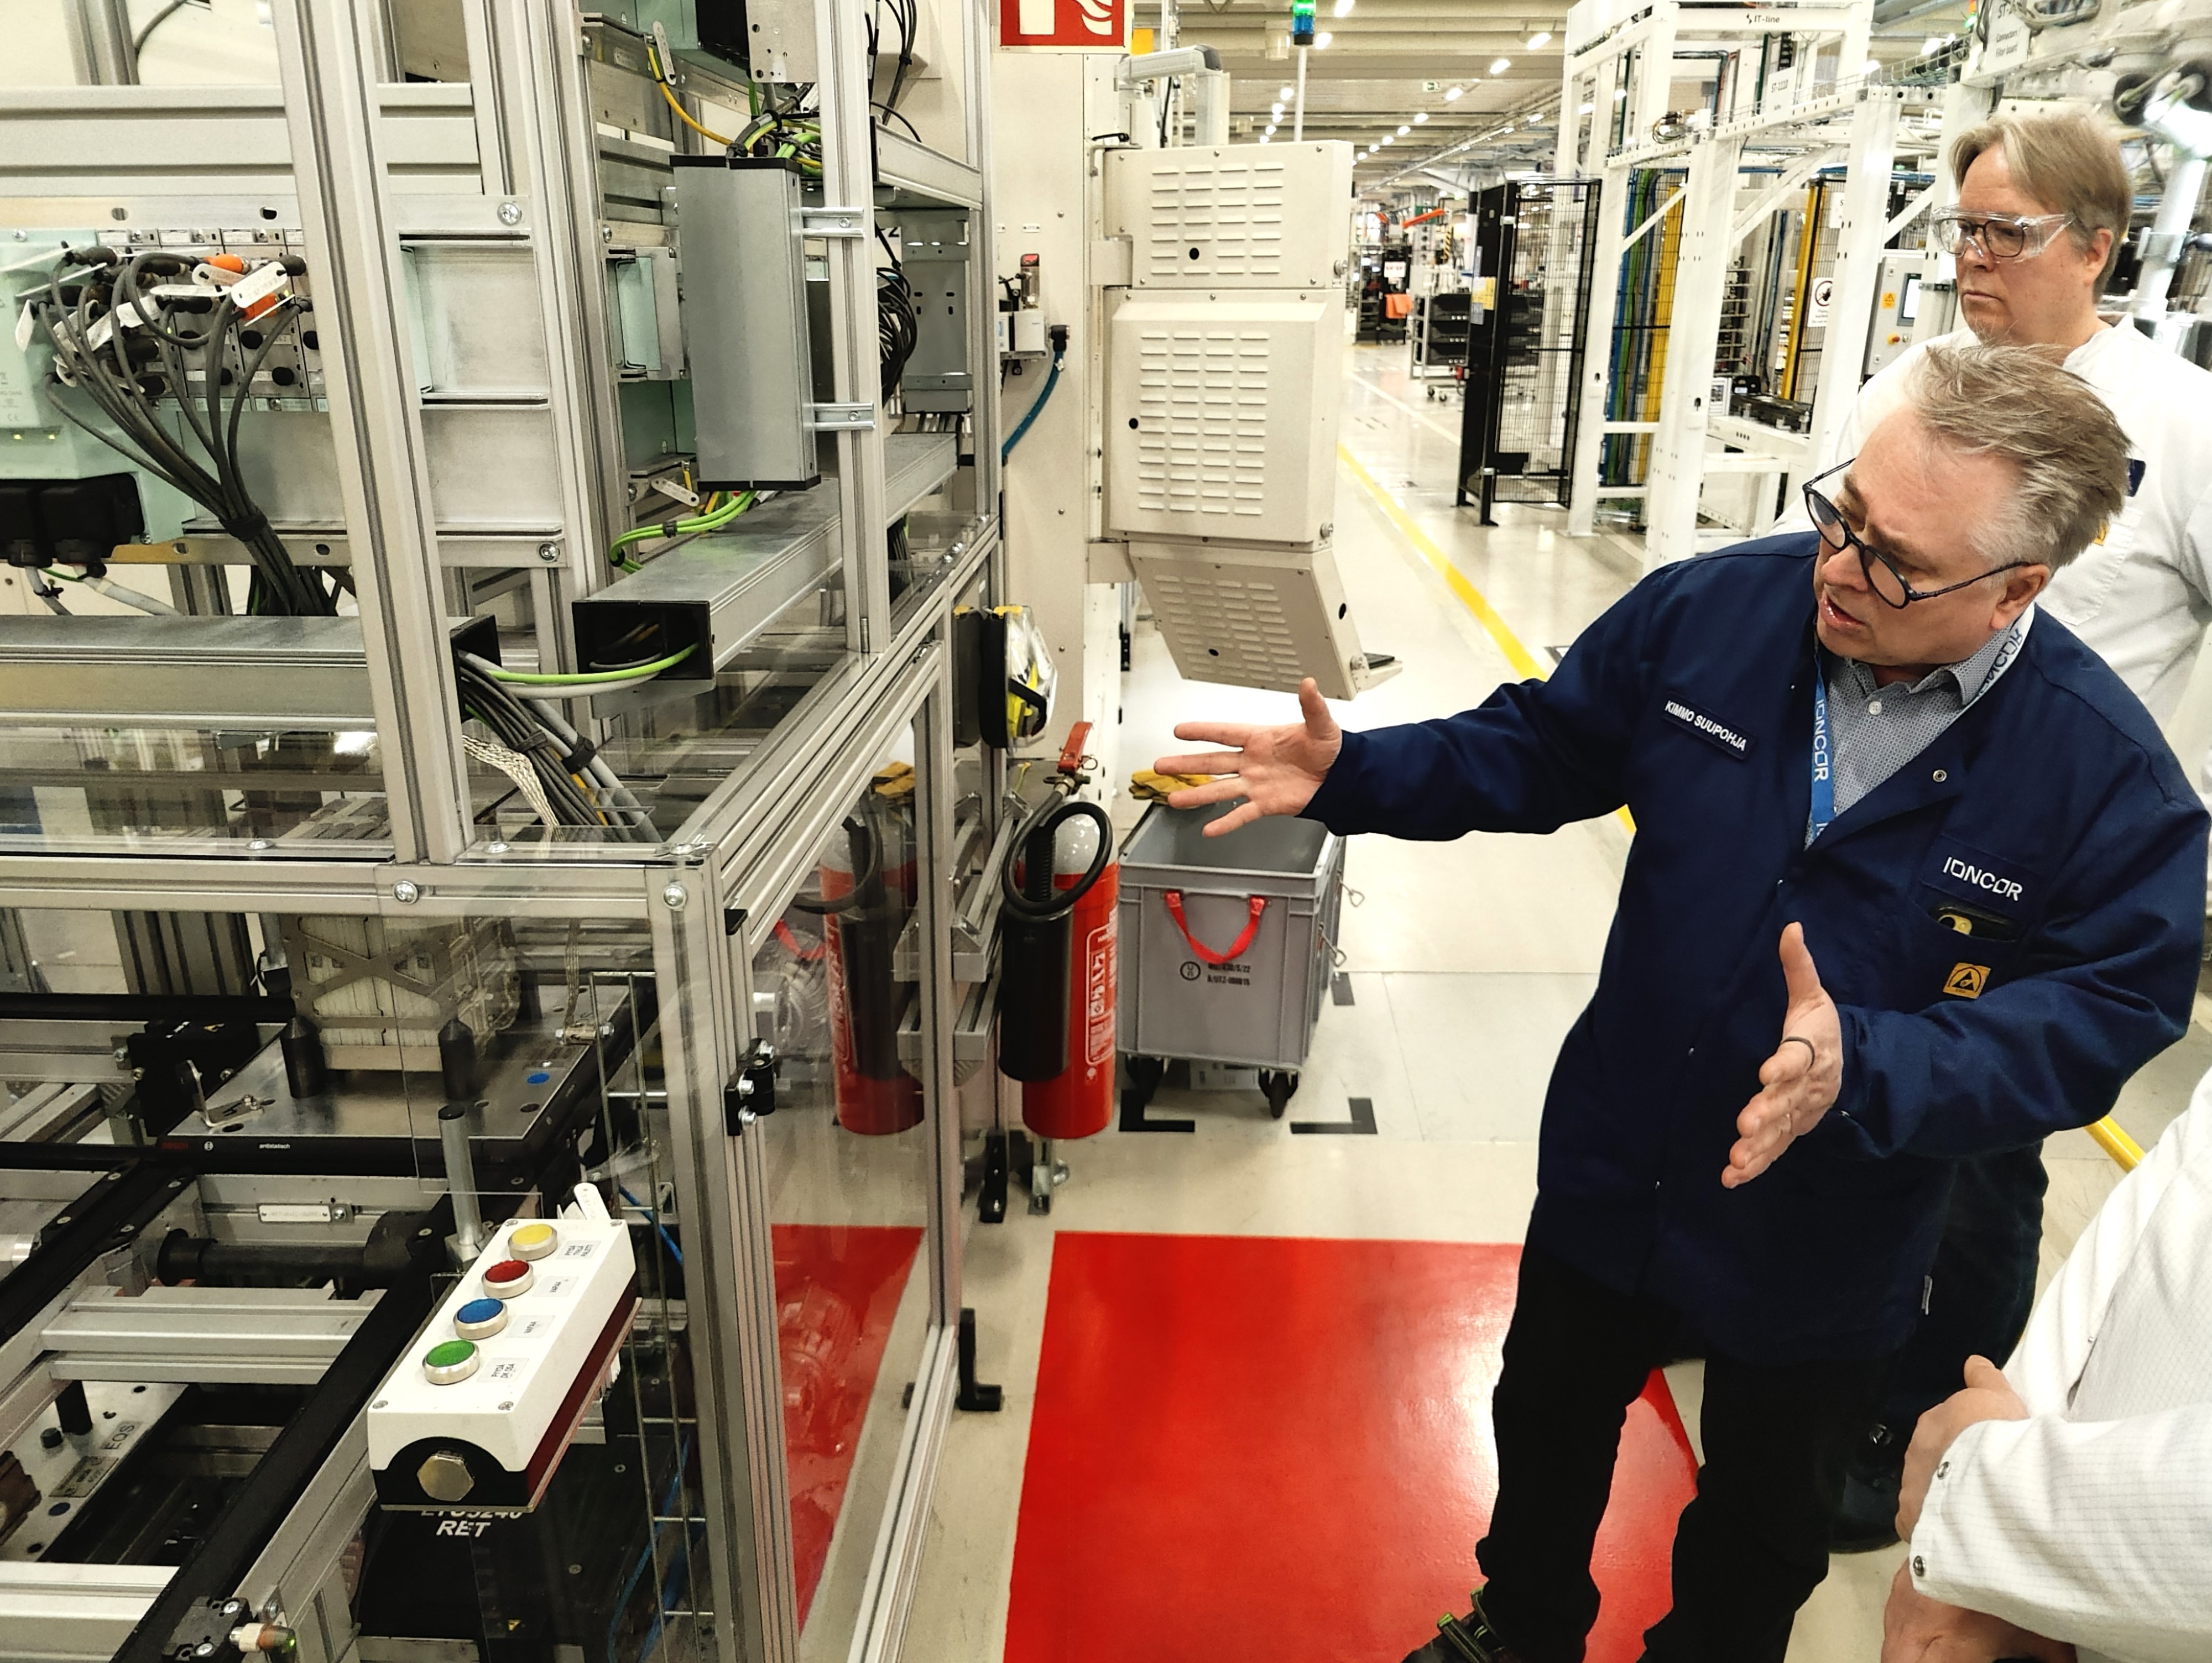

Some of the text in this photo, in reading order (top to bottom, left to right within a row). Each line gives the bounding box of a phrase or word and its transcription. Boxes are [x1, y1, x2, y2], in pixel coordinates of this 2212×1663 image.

[1754, 14, 1780, 23] IT-line
[1665, 700, 1747, 751] KIMMO SUUPOHJA
[1814, 699, 1829, 782] IONCOR
[1943, 856, 2023, 901] IONCOR
[436, 1520, 491, 1537] RET
